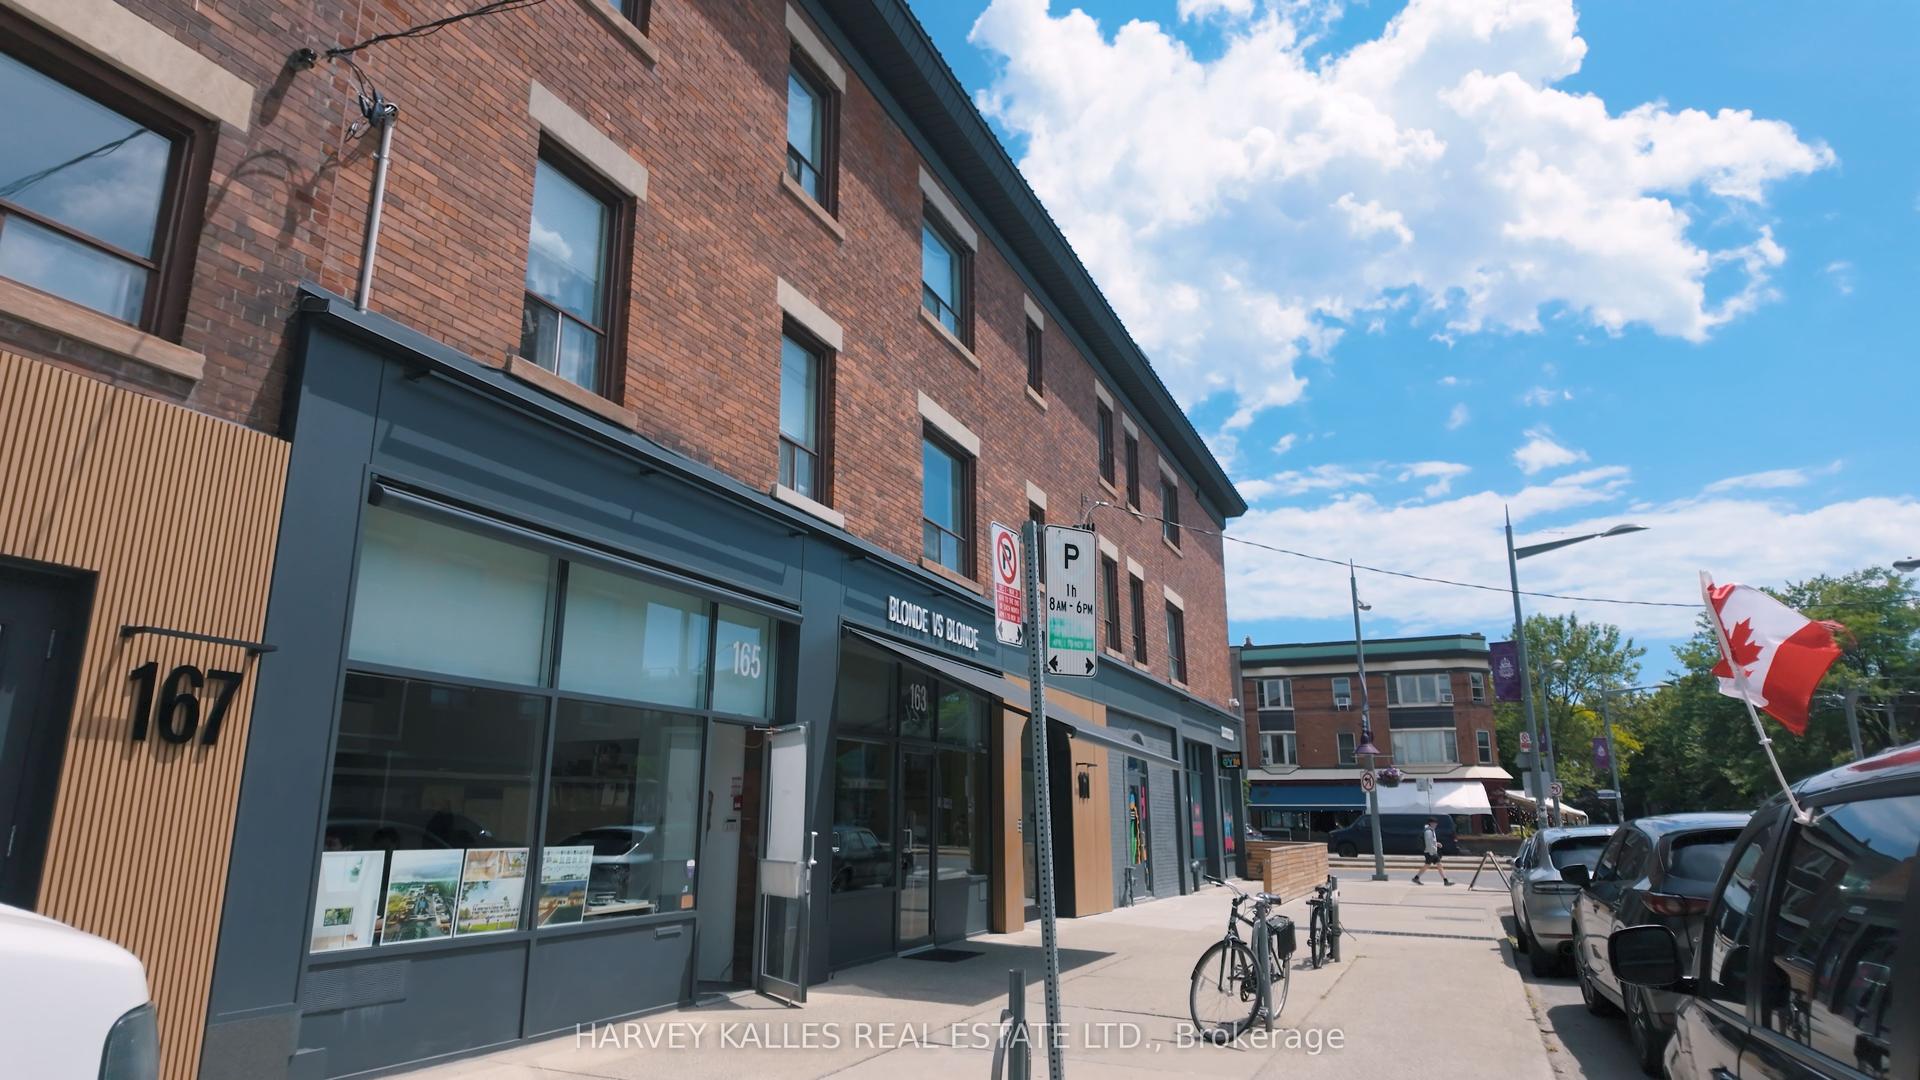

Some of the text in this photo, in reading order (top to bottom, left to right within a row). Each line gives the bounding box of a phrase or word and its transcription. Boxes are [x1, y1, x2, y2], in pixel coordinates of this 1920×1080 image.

[1064, 543, 1080, 569] P
[888, 595, 929, 633] BLONDE
[932, 611, 944, 638] VS
[945, 617, 979, 651] BLONDE
[733, 640, 761, 679] 165
[129, 661, 244, 746] 167
[910, 682, 927, 712] 163
